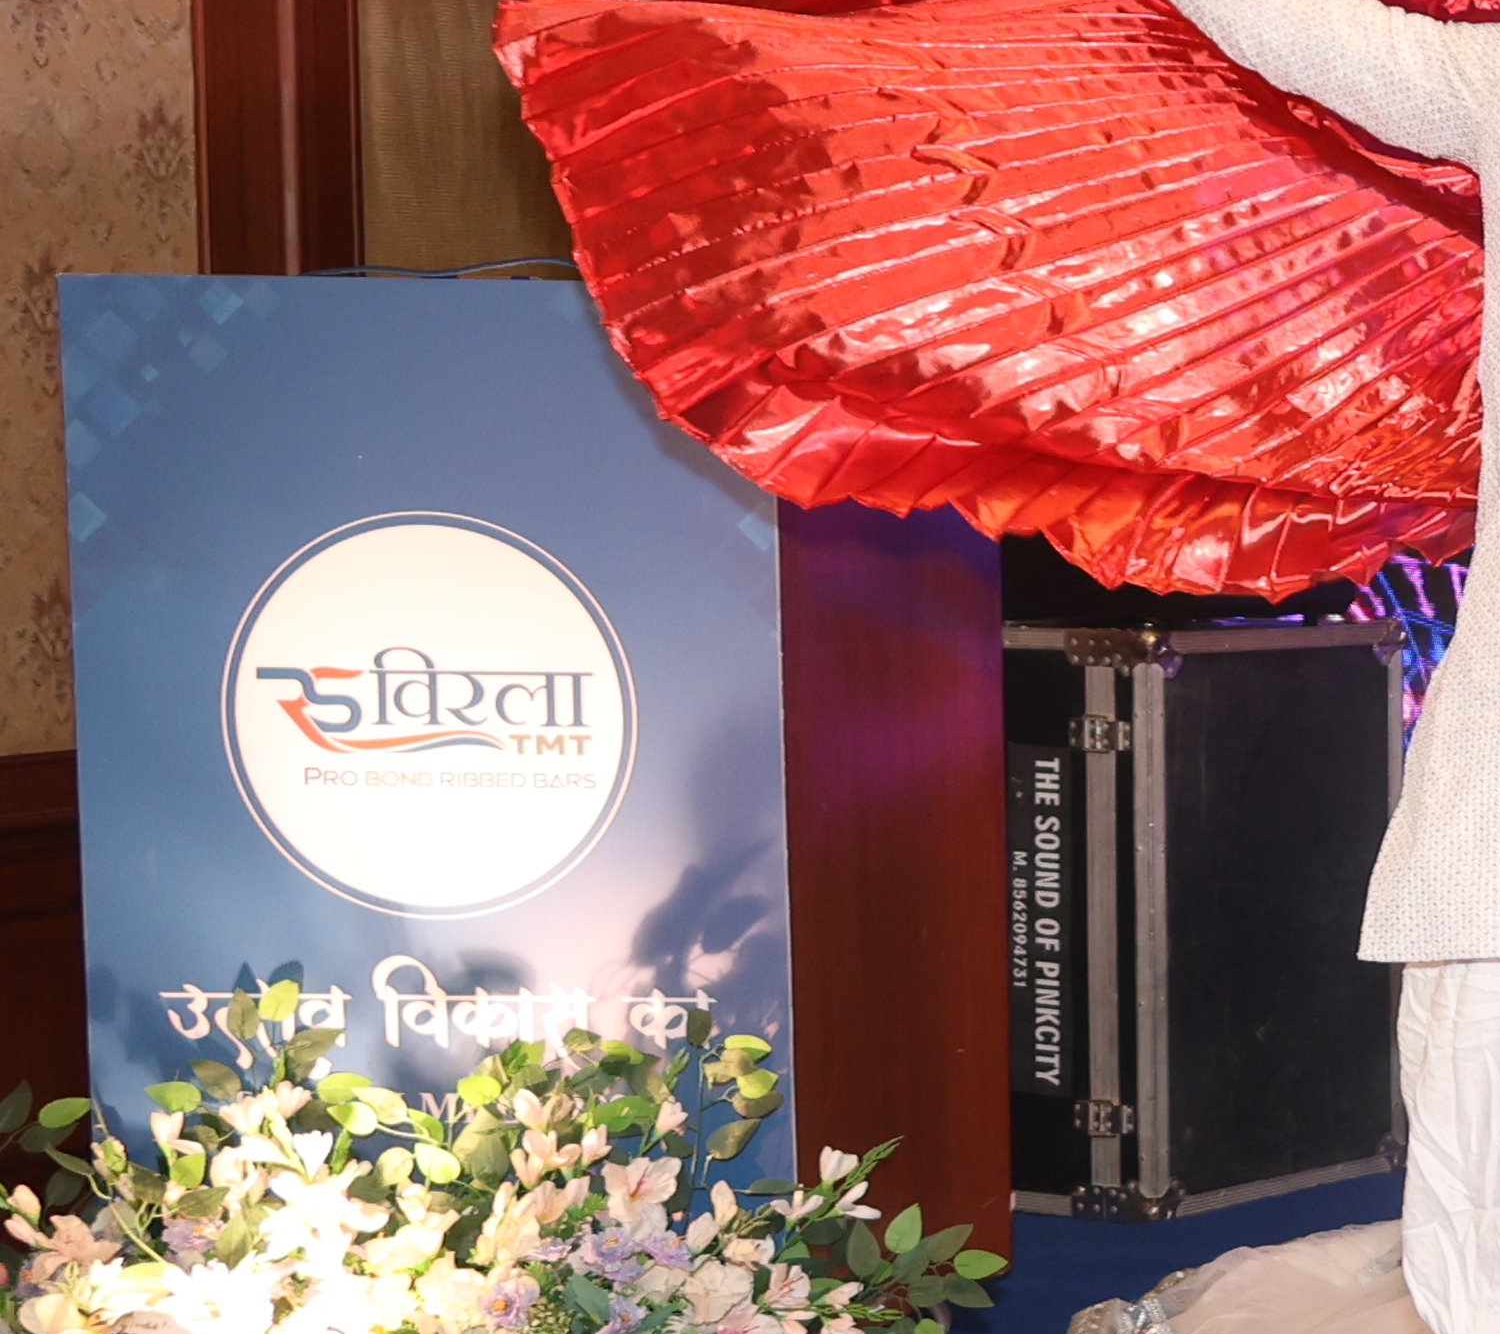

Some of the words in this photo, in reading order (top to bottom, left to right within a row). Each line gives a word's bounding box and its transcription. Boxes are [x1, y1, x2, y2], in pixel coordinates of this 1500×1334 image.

[509, 733, 593, 756] TMT
[304, 767, 358, 786] PRO
[365, 769, 434, 787] BOND
[440, 770, 527, 788] RIBBED
[533, 772, 597, 789] BARS
[1035, 757, 1061, 807] THE
[1035, 815, 1061, 909] SOUND
[1035, 918, 1061, 953] OF
[1035, 961, 1061, 1087] PINKCITY
